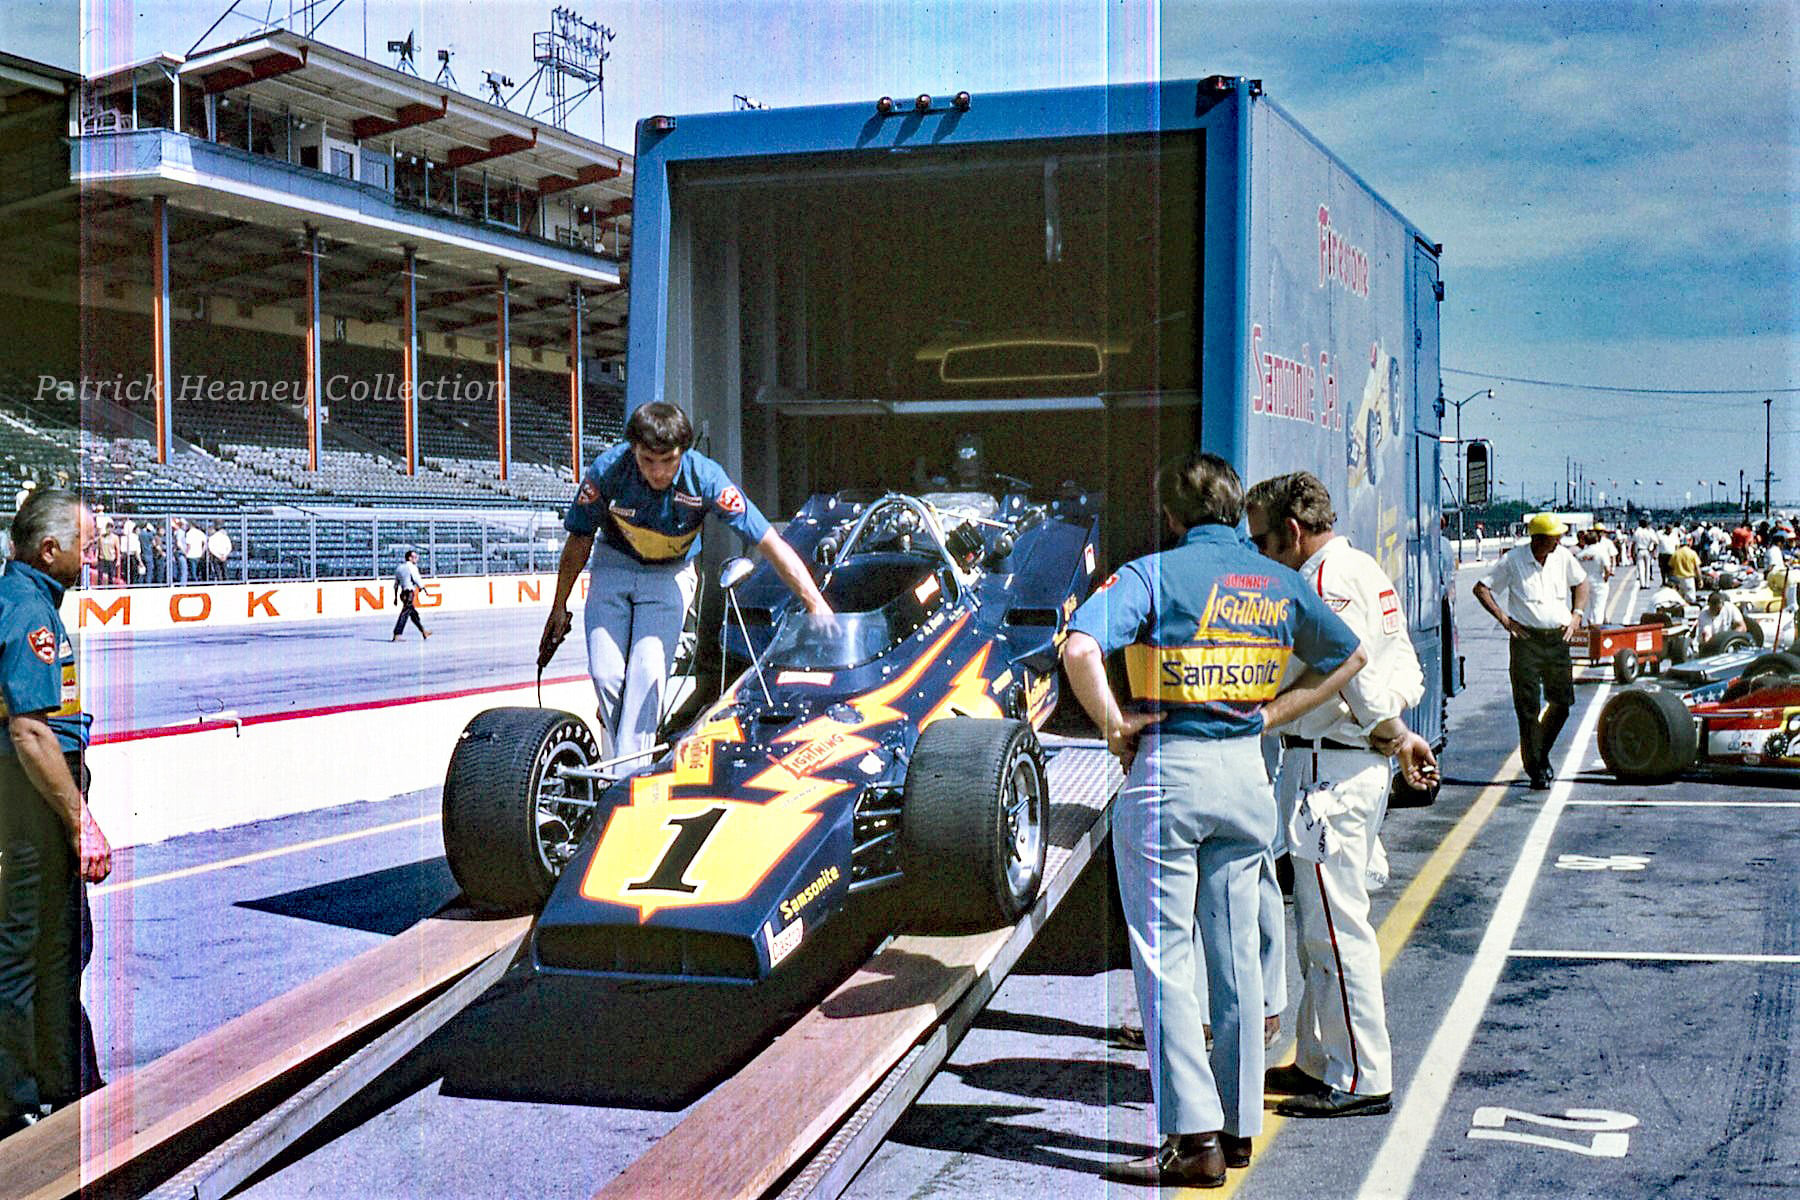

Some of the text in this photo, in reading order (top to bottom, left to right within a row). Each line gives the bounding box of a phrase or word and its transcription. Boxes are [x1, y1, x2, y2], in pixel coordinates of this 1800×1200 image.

[1317, 203, 1370, 300] Firestone
[80, 583, 443, 627] MOKING
[488, 578, 541, 605] IN
[1224, 574, 1269, 588] JOHNNY
[1193, 583, 1290, 641] LIGHTNING
[1161, 659, 1280, 686] Samsonit
[767, 733, 846, 779] LIGHTNING
[627, 806, 728, 893] 1
[779, 865, 840, 920] Samsonite
[1466, 1106, 1640, 1158] 27
